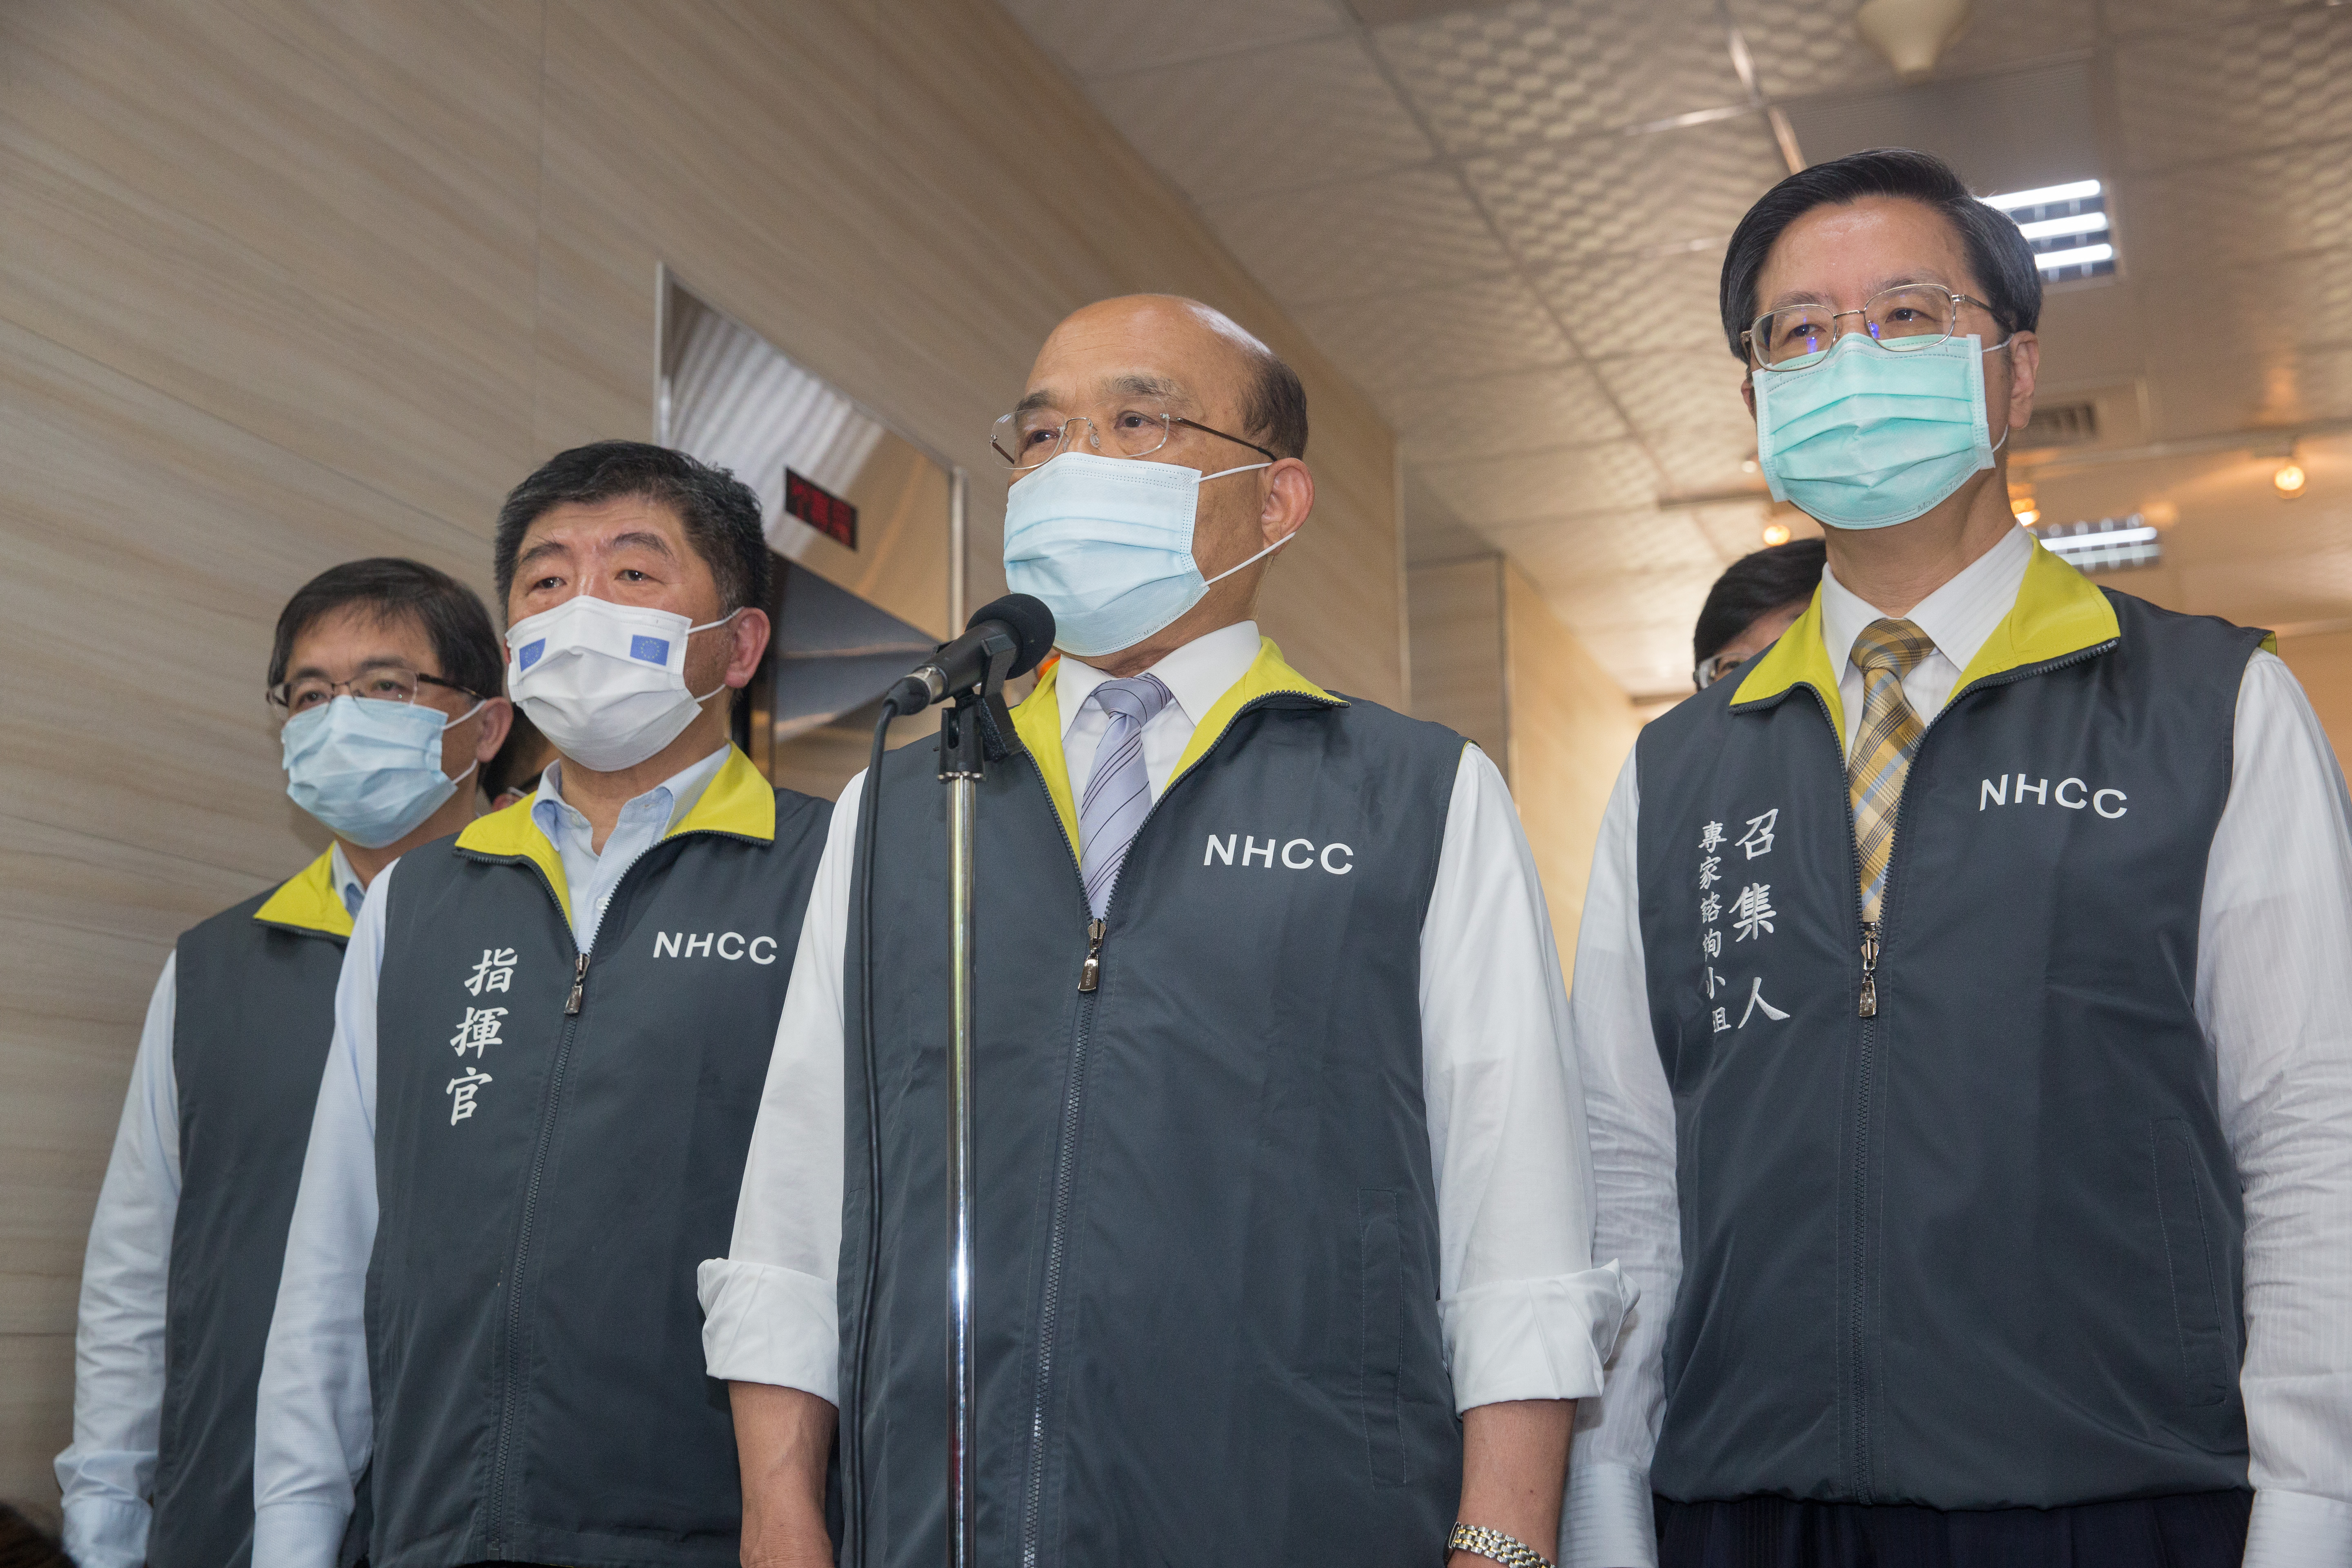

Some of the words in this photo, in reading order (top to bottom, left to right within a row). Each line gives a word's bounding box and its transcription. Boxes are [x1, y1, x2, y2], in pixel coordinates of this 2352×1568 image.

[1918, 495, 1939, 511] Made
[1940, 489, 1947, 497] In
[1144, 625, 1160, 636] Made
[1167, 605, 1188, 621] Taiwan
[1979, 773, 2127, 819] NHCC
[1203, 834, 1354, 875] NHCC
[1729, 808, 1790, 1029] 召集人
[653, 931, 777, 965] NHCC
[446, 947, 518, 1126] 指揮官
